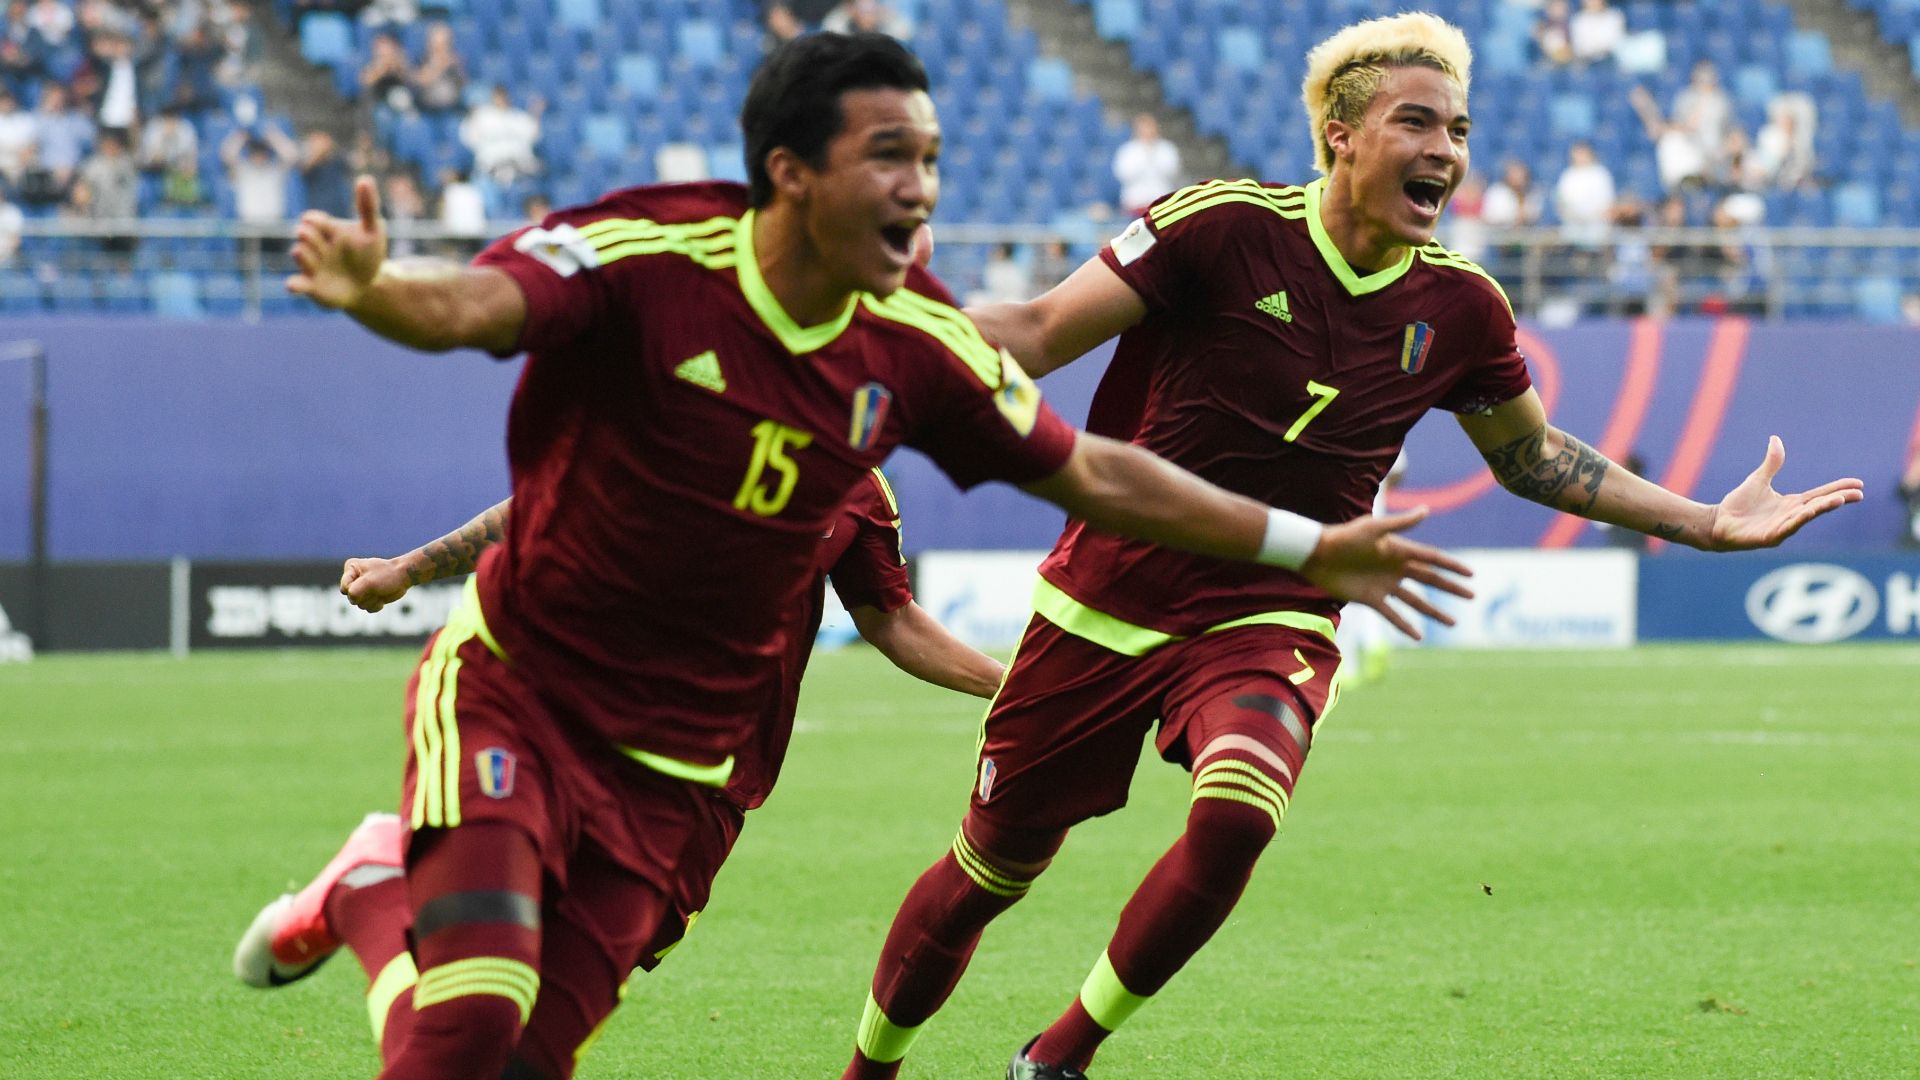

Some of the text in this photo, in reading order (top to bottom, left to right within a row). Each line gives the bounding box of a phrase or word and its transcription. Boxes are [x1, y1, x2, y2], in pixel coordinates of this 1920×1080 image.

[1255, 300, 1292, 323] adidas
[1283, 379, 1340, 442] 7
[733, 420, 814, 516] 15
[1288, 648, 1316, 686] 7
